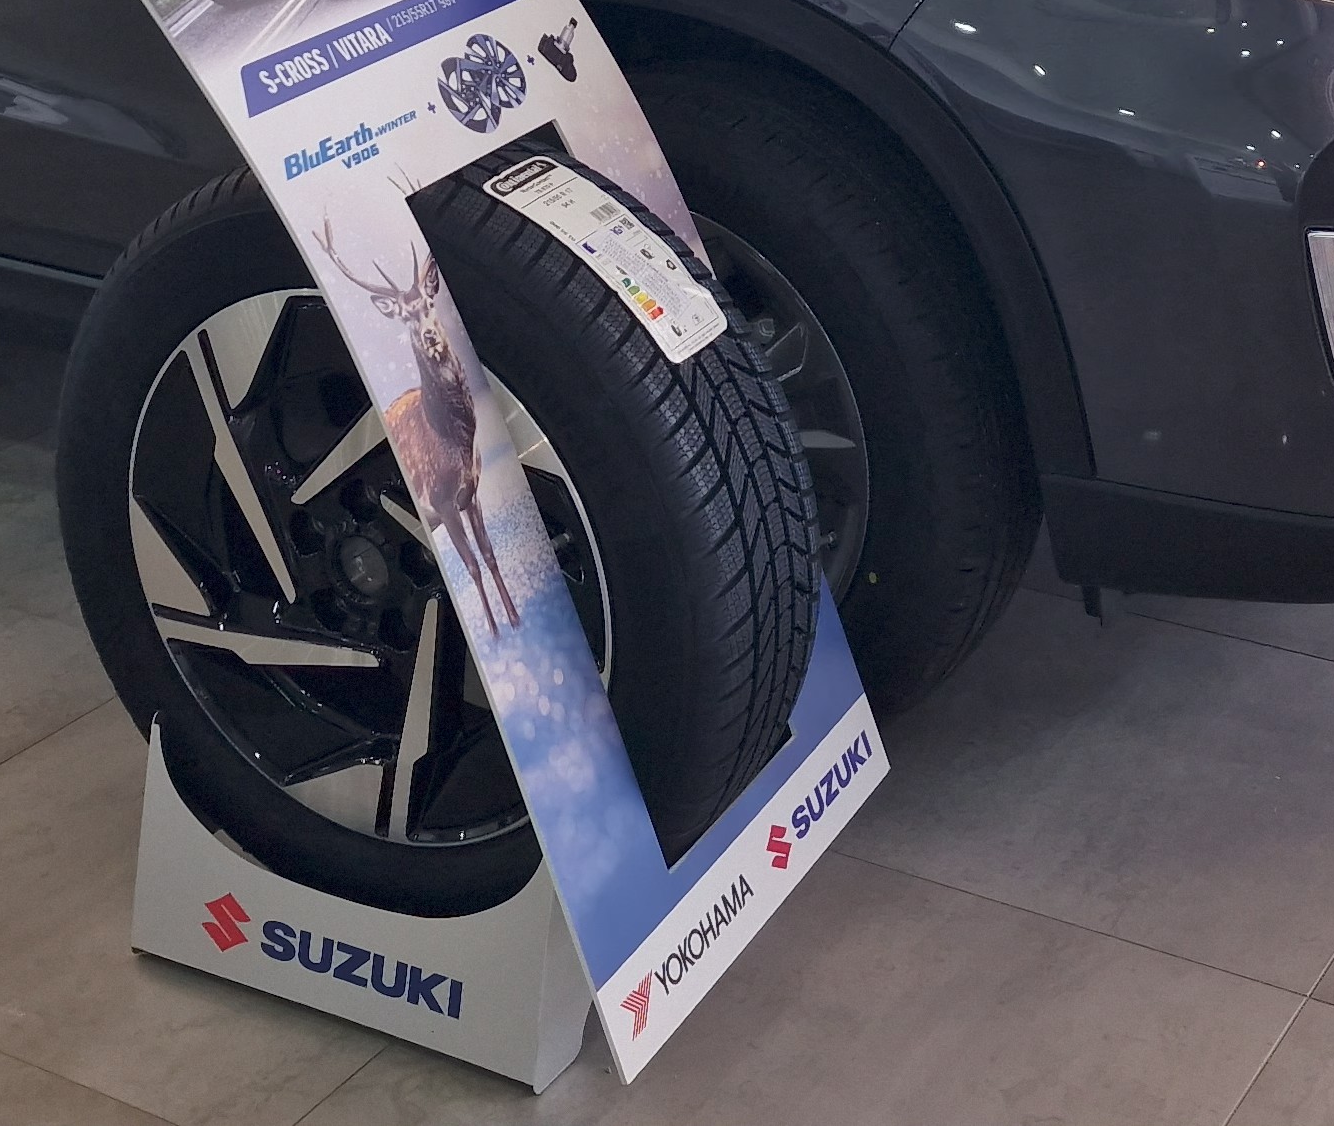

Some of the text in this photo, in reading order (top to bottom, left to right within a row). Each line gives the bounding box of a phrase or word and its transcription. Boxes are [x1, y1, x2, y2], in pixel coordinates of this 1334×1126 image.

[258, 48, 330, 94] S-CROSS
[333, 22, 394, 62] VITARA
[391, 2, 439, 28] 215/55R17
[341, 143, 380, 169] V906
[653, 729, 873, 995] YOKOHAMA SUZUKI
[260, 919, 463, 1020] SUZUKI
